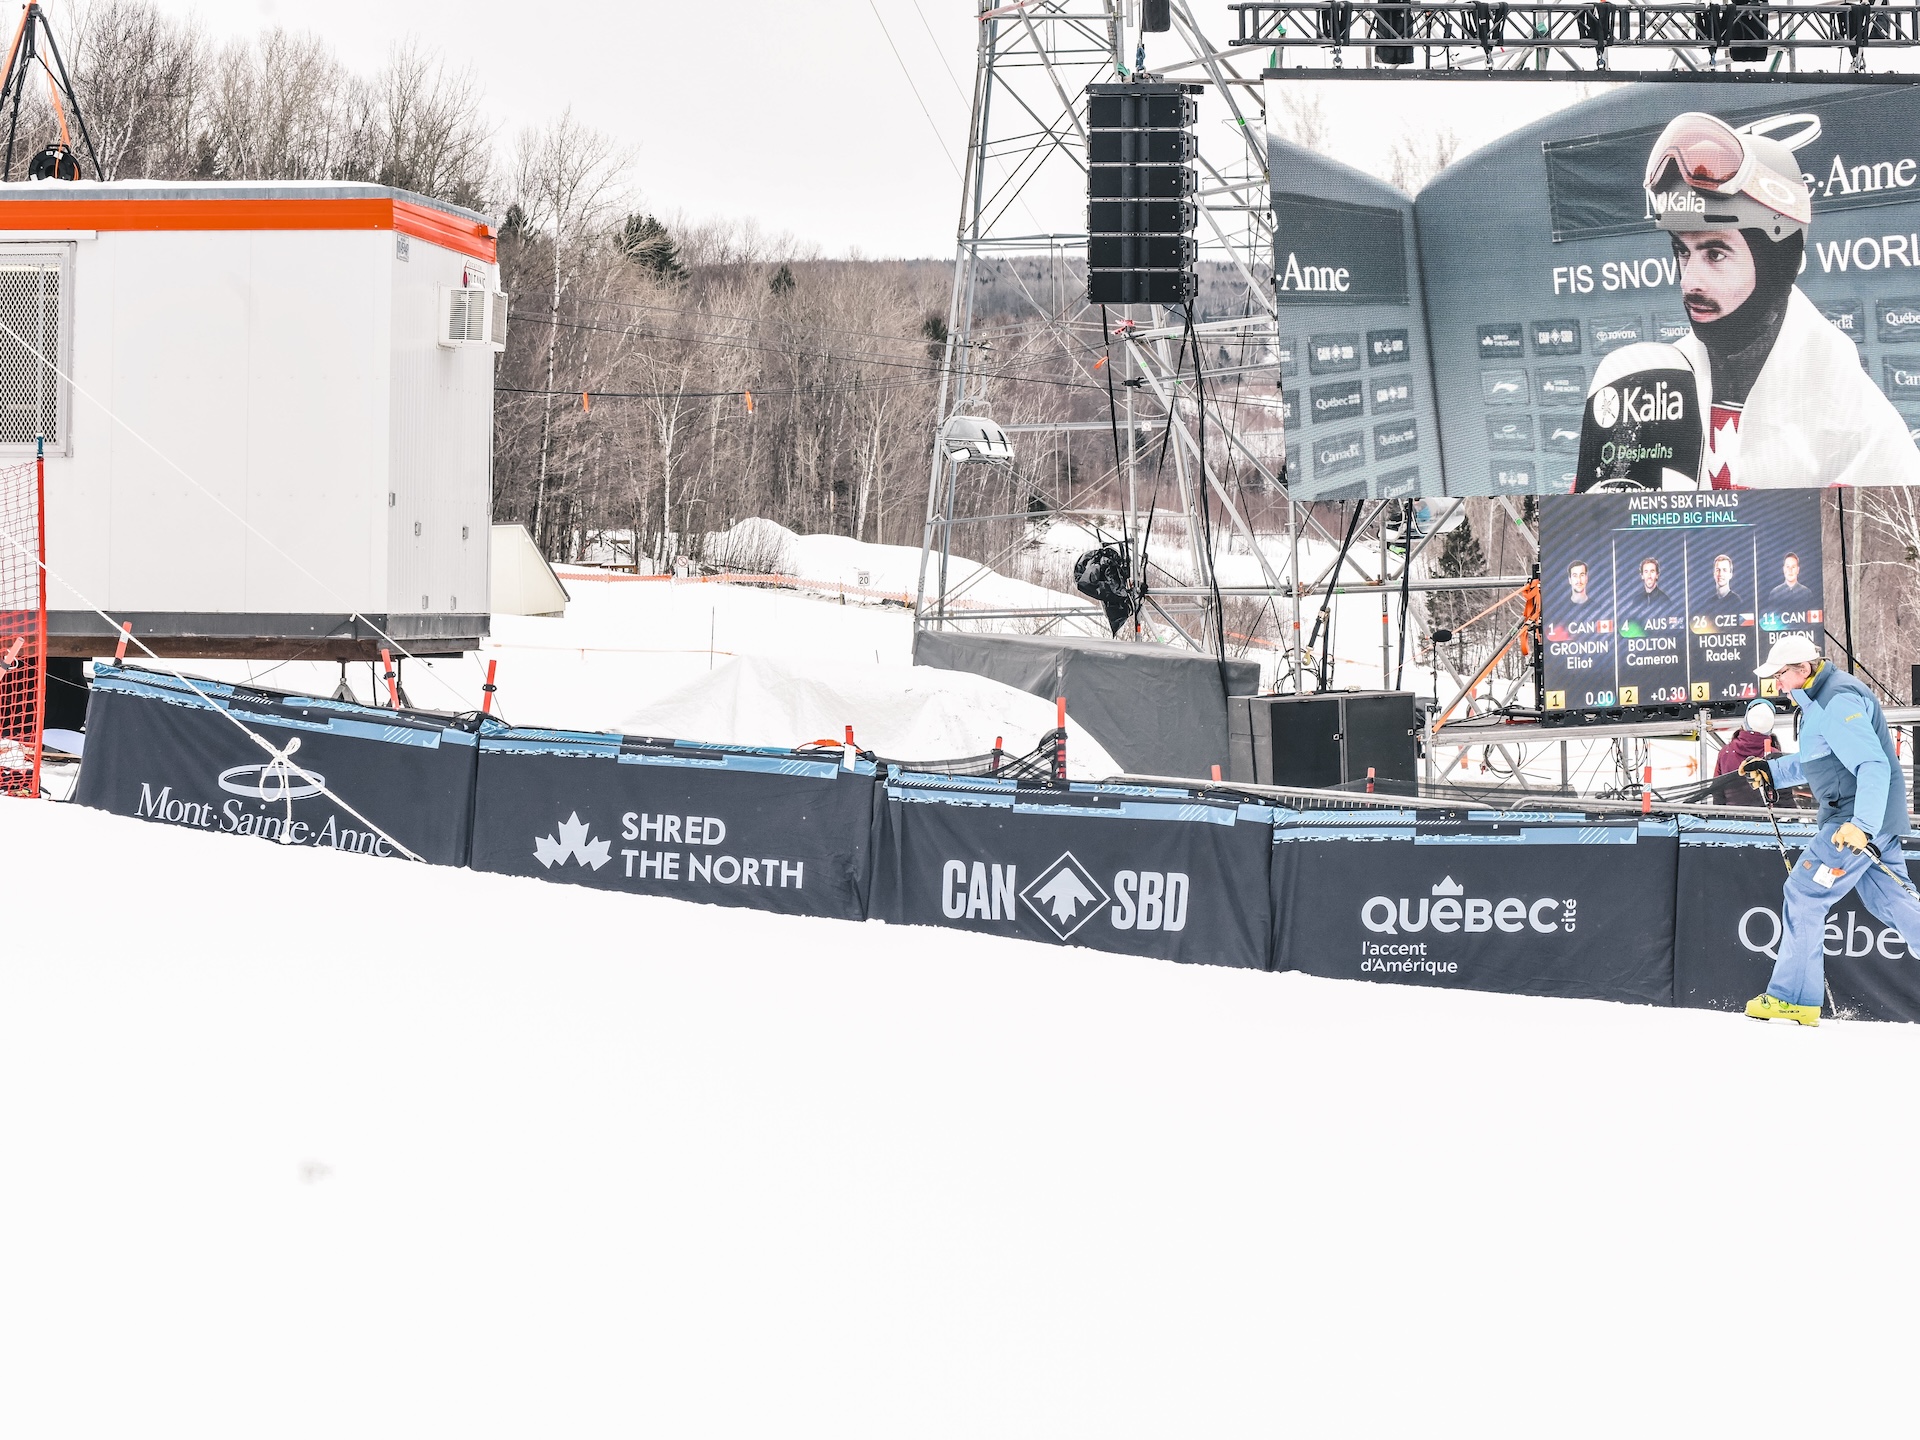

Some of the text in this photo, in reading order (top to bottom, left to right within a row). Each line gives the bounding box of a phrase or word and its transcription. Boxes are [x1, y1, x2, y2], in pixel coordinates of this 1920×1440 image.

[1667, 190, 1706, 213] Kalia
[1553, 265, 1594, 294] FIS
[1607, 330, 1637, 340] TOYOTA
[1622, 381, 1684, 423] Kalia
[1618, 442, 1673, 462] Desjardins
[1628, 493, 1739, 510] MEN'S SBX FINALS
[1631, 510, 1738, 525] FINISHED BIG FINAL
[859, 576, 869, 585] 20
[1621, 618, 1667, 632] 4 AUS
[1692, 614, 1737, 628] 26 CZE
[1762, 611, 1806, 625] 11 CAN
[1548, 621, 1595, 635] 1 CAN
[1628, 637, 1676, 652] BOLTON
[1699, 633, 1747, 648] HOUSER
[1550, 641, 1609, 656] GRONDIN
[1706, 648, 1741, 661] Radek
[1567, 656, 1593, 669] Eliot
[1626, 654, 1679, 666] Cameron
[1625, 687, 1686, 702] 2 +0.30
[1697, 683, 1756, 699] 3 +0.71
[1766, 682, 1774, 694] 4
[1552, 691, 1614, 707] 1 0.00
[621, 812, 726, 846] SHRED
[621, 849, 804, 889] THE NORTH
[942, 859, 1190, 932] CAN SBD
[1561, 898, 1577, 933] cité
[1362, 941, 1428, 956] l'accent
[1360, 958, 1458, 976] d'Amérique
